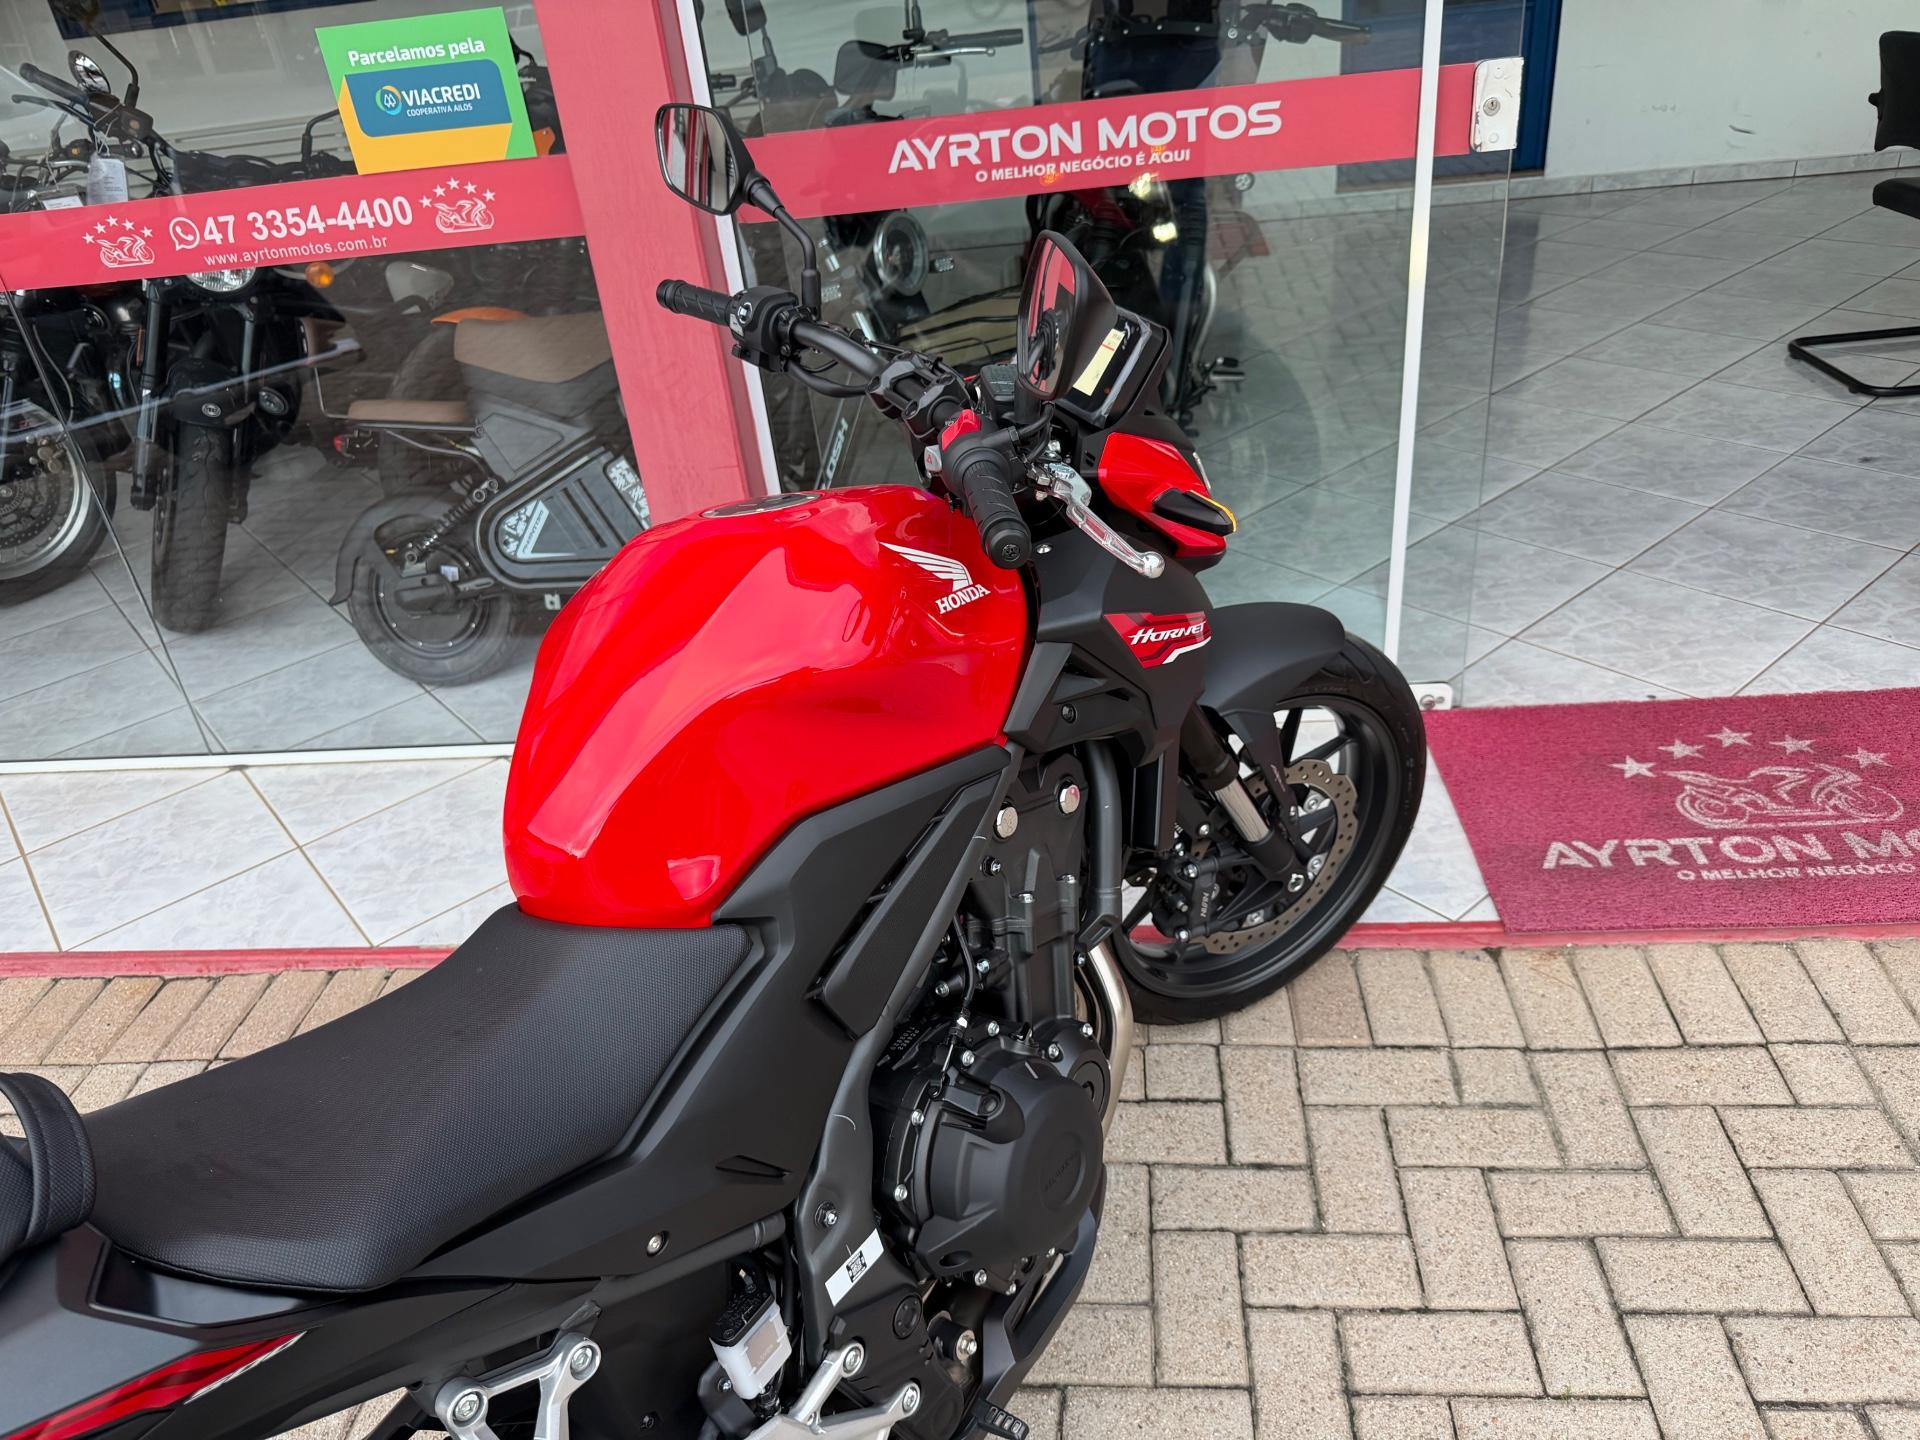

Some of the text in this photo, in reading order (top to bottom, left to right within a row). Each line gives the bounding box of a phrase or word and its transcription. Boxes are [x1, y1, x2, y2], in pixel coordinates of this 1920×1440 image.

[347, 38, 486, 67] Parcelamos pela
[401, 82, 481, 107] VIACREDI
[406, 103, 473, 117] COOPERATIVA AILOS
[887, 100, 1282, 174] AYRTON MOTOS
[975, 148, 1191, 184] O MELHOR NEGÓCIO É AQUI
[203, 195, 413, 246] 47 3354-4400
[203, 235, 388, 267] www.ayrtonmotos.com.br
[935, 583, 991, 615] HONDA
[1128, 620, 1207, 646] HORNET
[1542, 828, 1920, 870] AYRTON M
[1676, 869, 1697, 881] O
[1701, 866, 1801, 881] MELHOR
